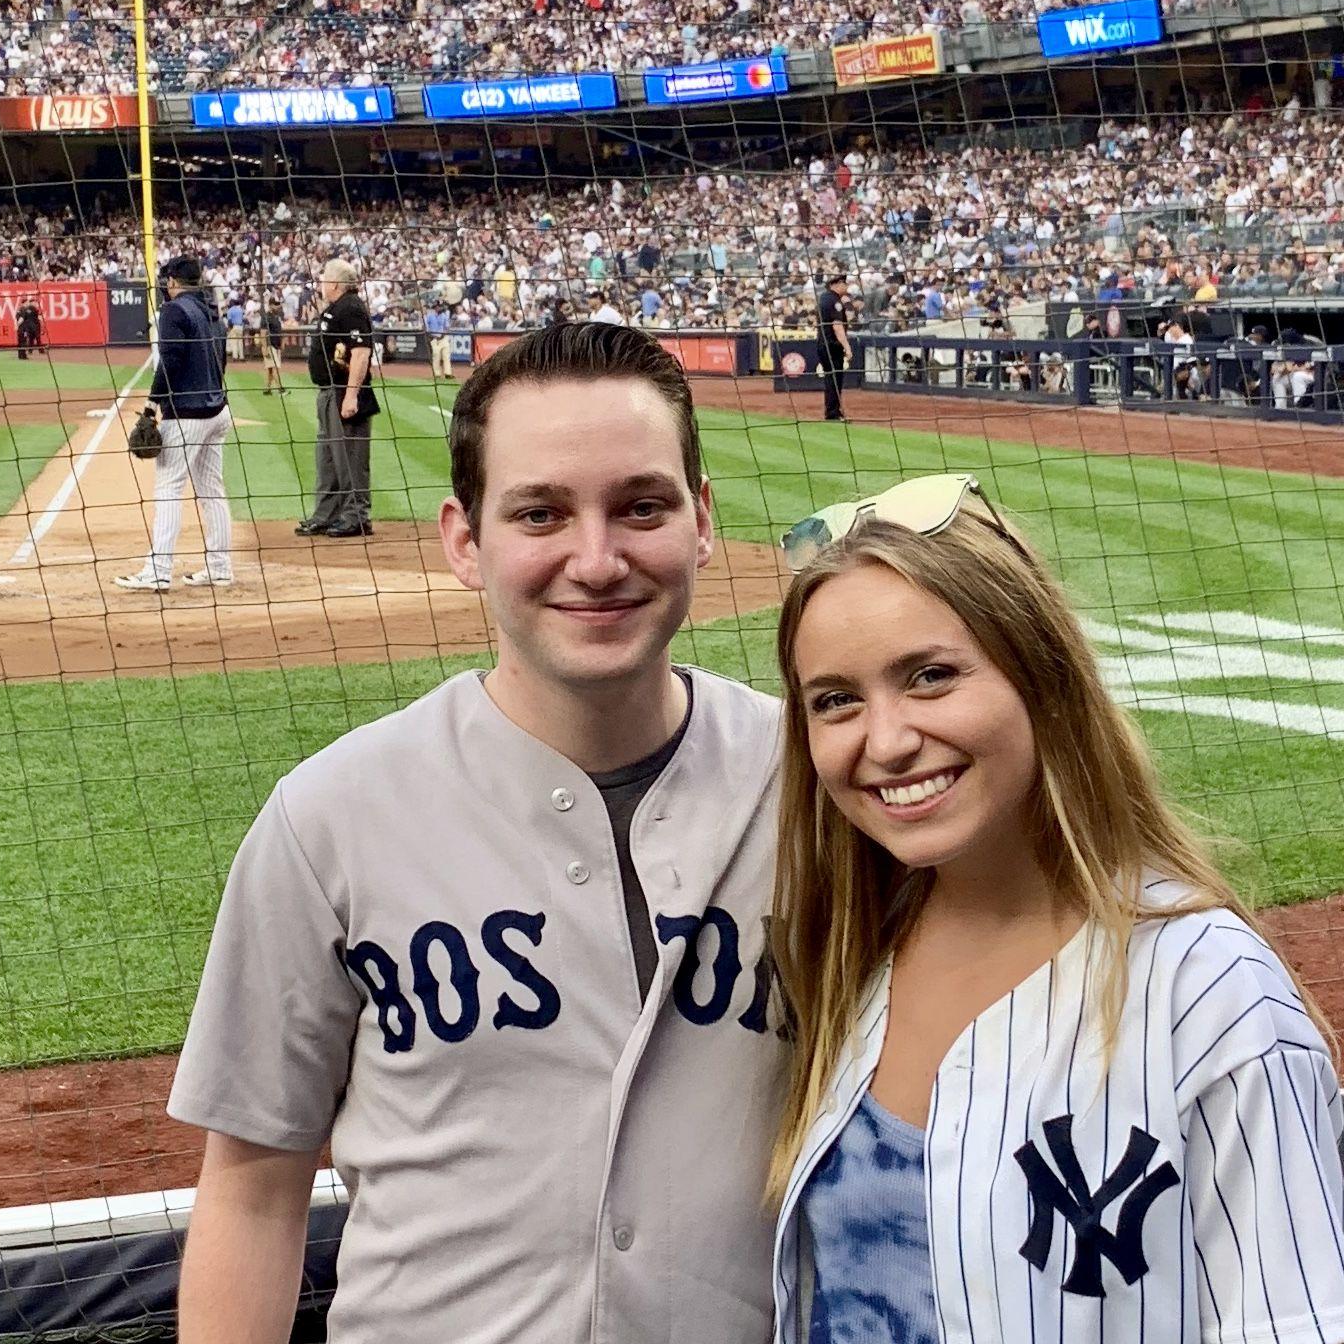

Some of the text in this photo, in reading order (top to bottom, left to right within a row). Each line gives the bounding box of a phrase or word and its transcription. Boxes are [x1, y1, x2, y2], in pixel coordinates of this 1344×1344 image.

[461, 82, 581, 109] (212) YANKEES
[111, 289, 133, 305] 314
[338, 909, 561, 1054] BOS
[1013, 1113, 1181, 1298] NY
